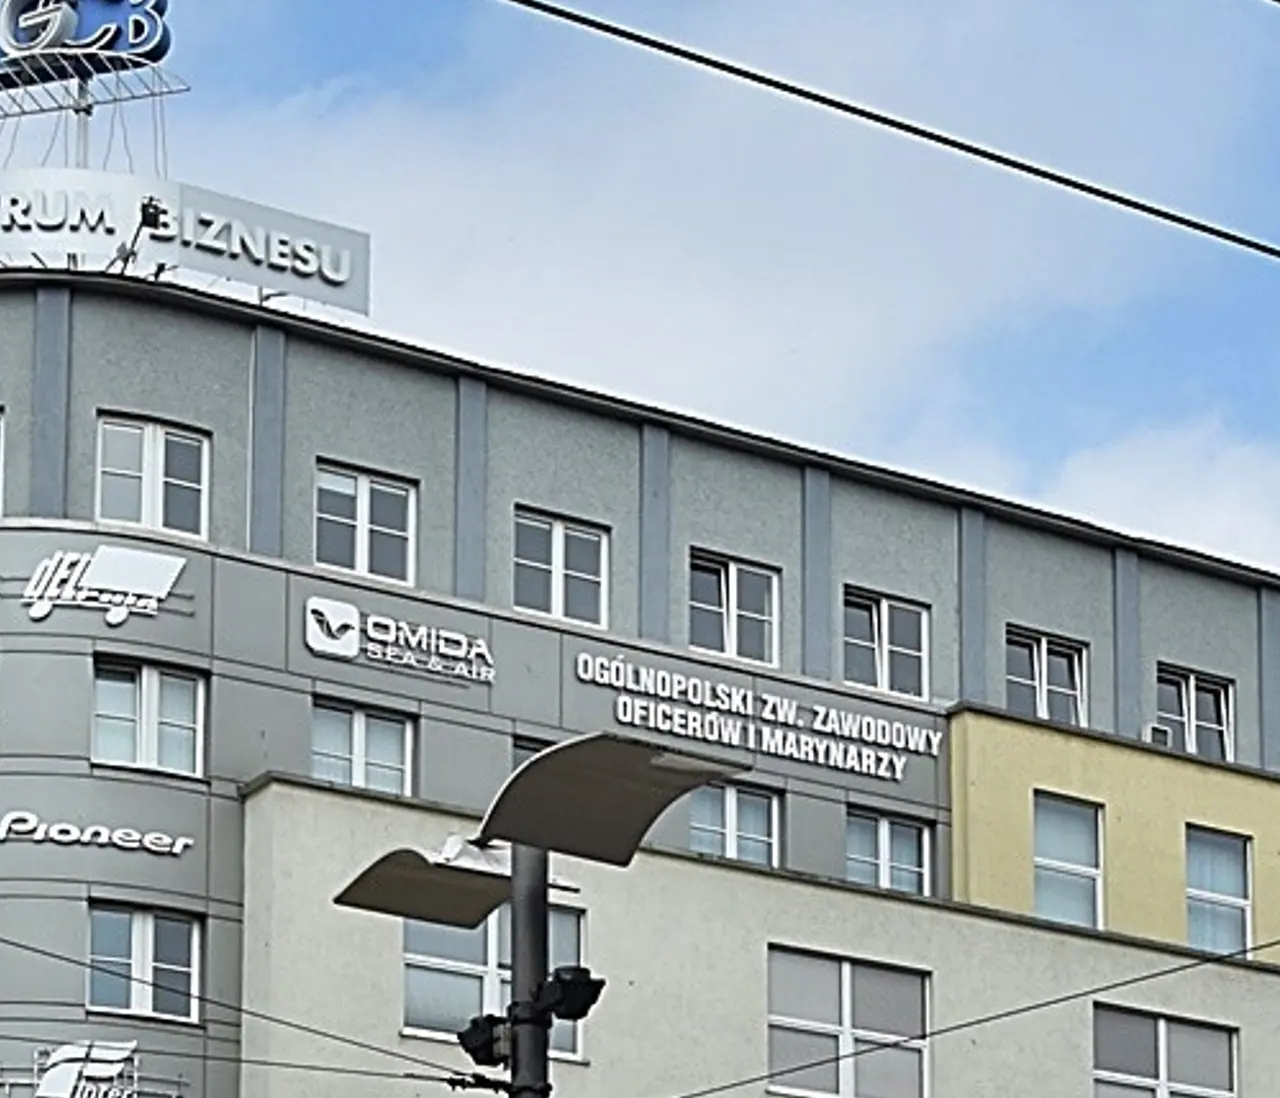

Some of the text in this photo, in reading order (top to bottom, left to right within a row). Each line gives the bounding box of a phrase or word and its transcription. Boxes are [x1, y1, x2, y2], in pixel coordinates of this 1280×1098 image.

[147, 198, 352, 287] BIZNESU
[366, 614, 494, 668] OMIDA
[366, 642, 497, 684] SEA & AIR
[576, 651, 944, 757] OGÓLNOPOLSKI ZW. ZAWODOWY
[616, 694, 909, 782] OFICERÓW I MARYNARZY
